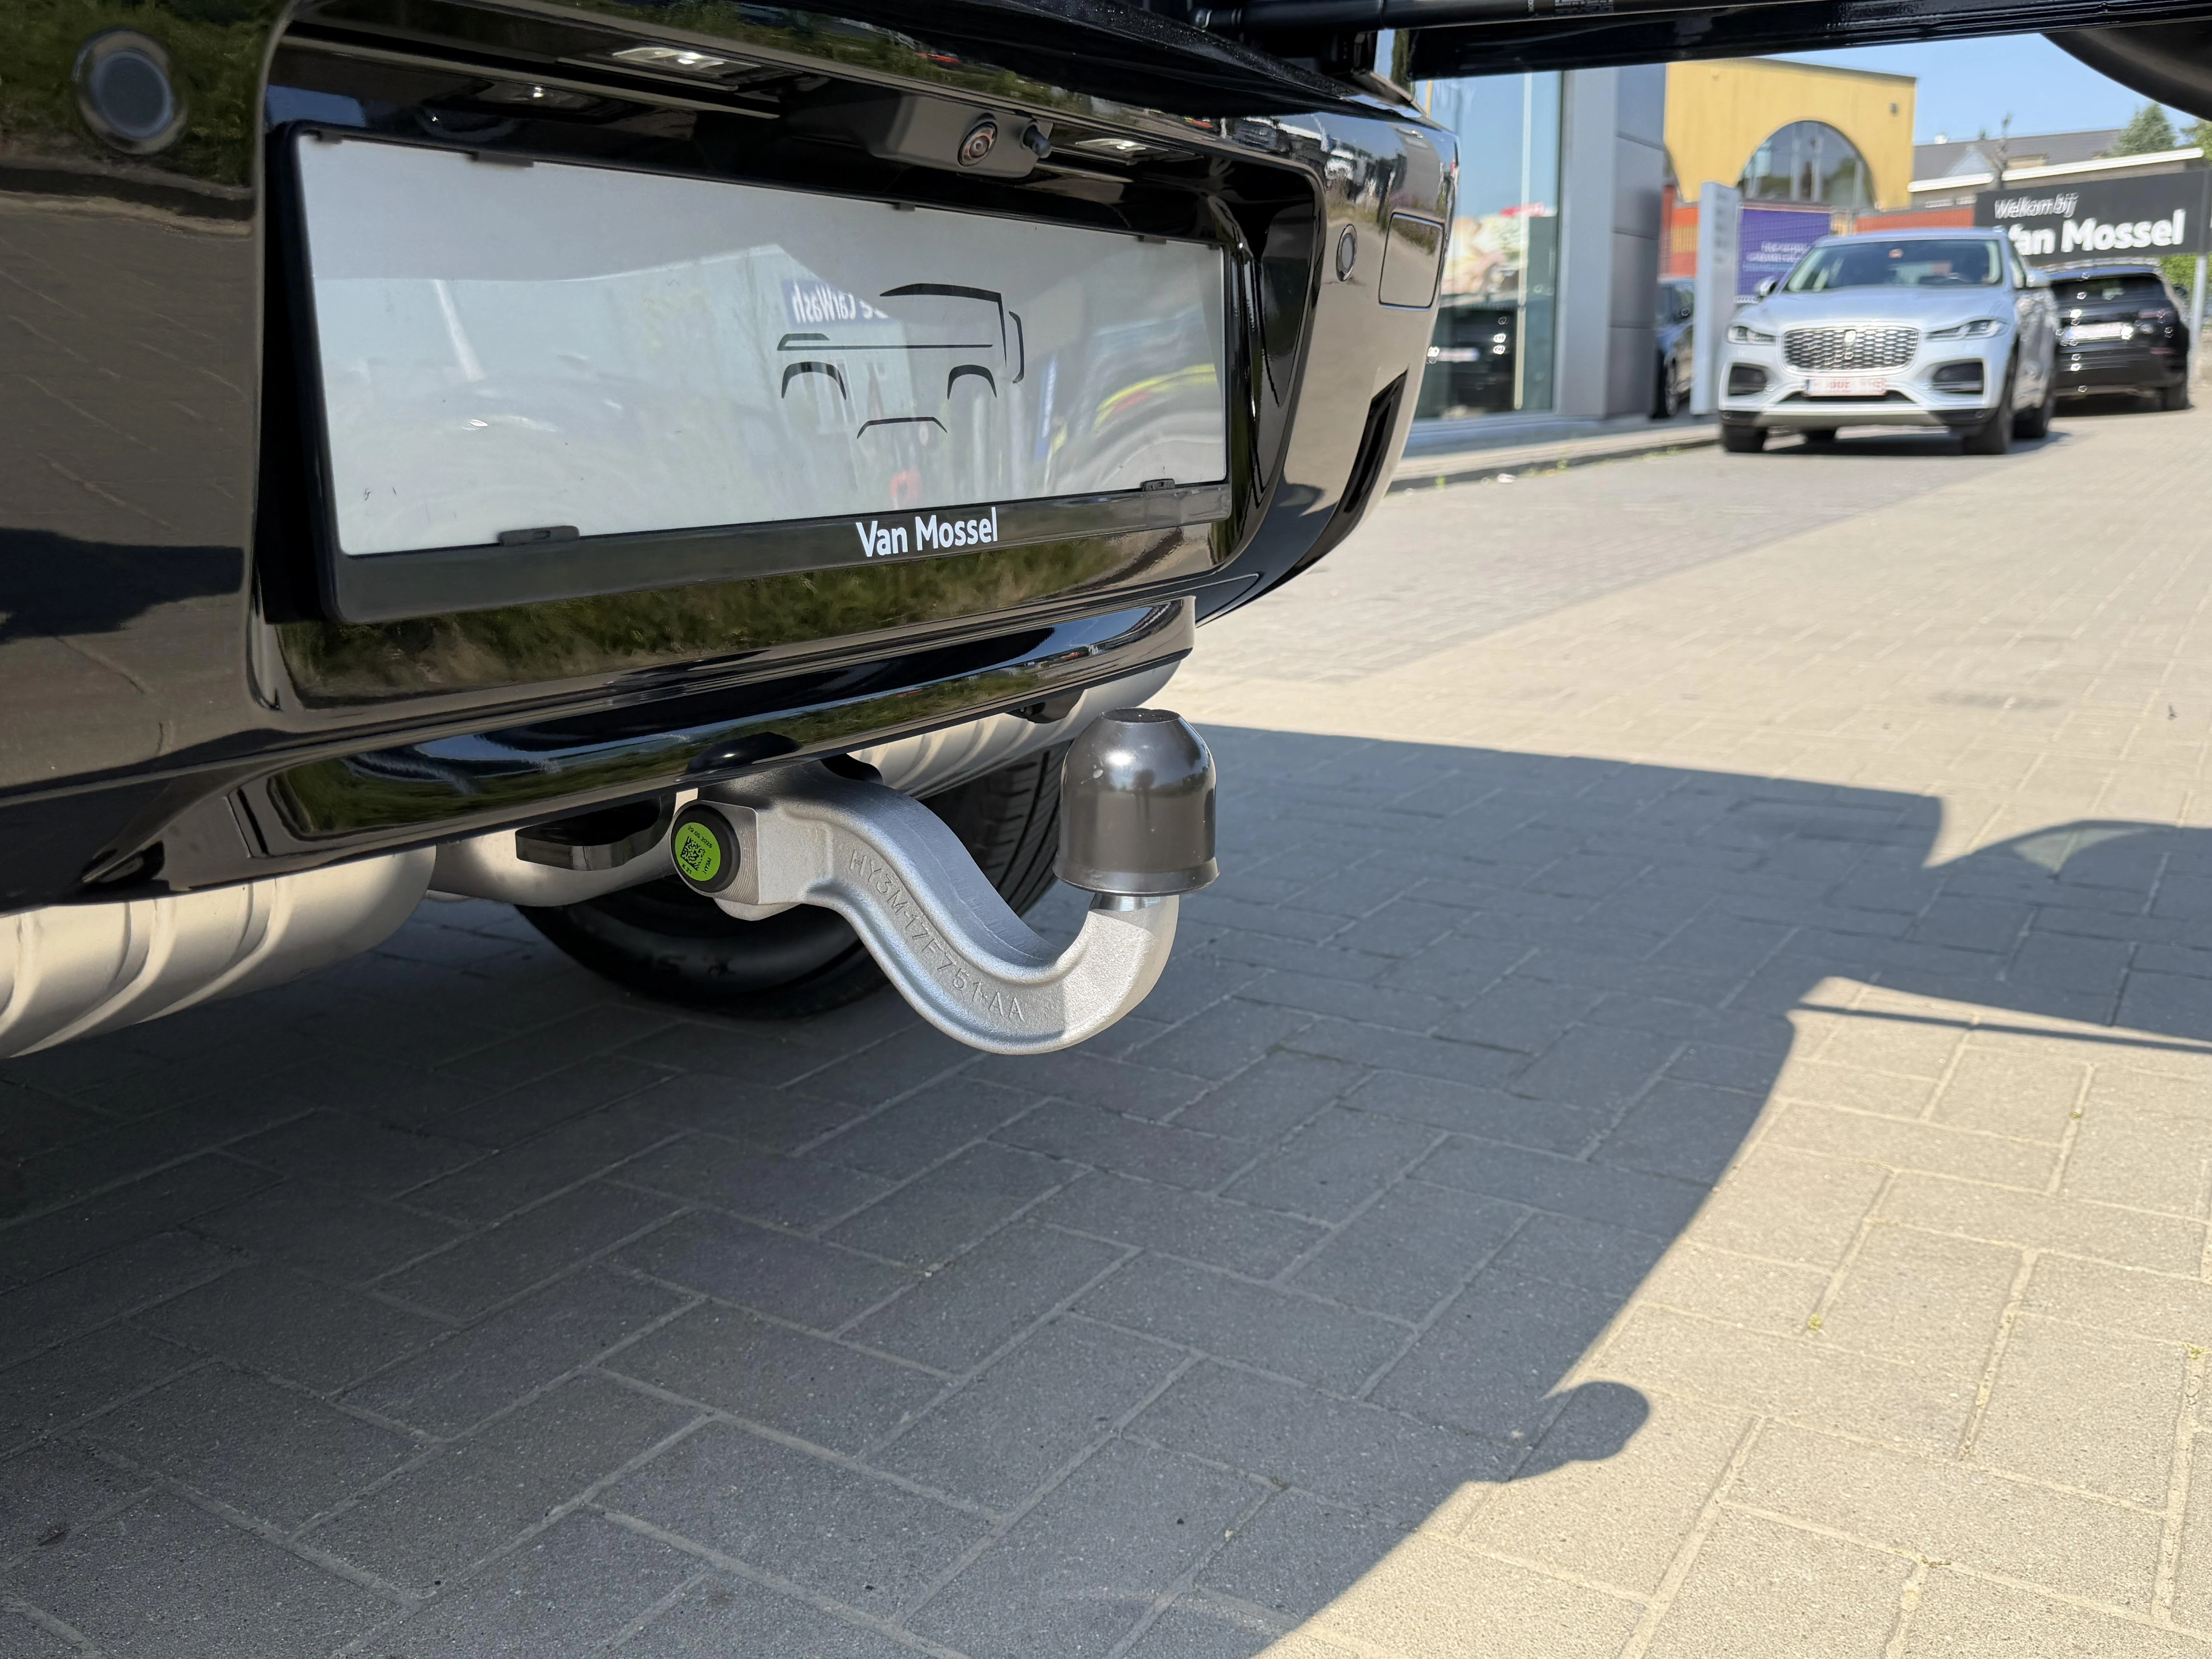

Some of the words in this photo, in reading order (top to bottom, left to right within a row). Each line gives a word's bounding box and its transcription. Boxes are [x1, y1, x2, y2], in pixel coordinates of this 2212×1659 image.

[1995, 196, 2054, 219] Welkom
[2061, 208, 2186, 252] Mossel
[855, 520, 908, 557] Van
[915, 507, 998, 551] Mossel
